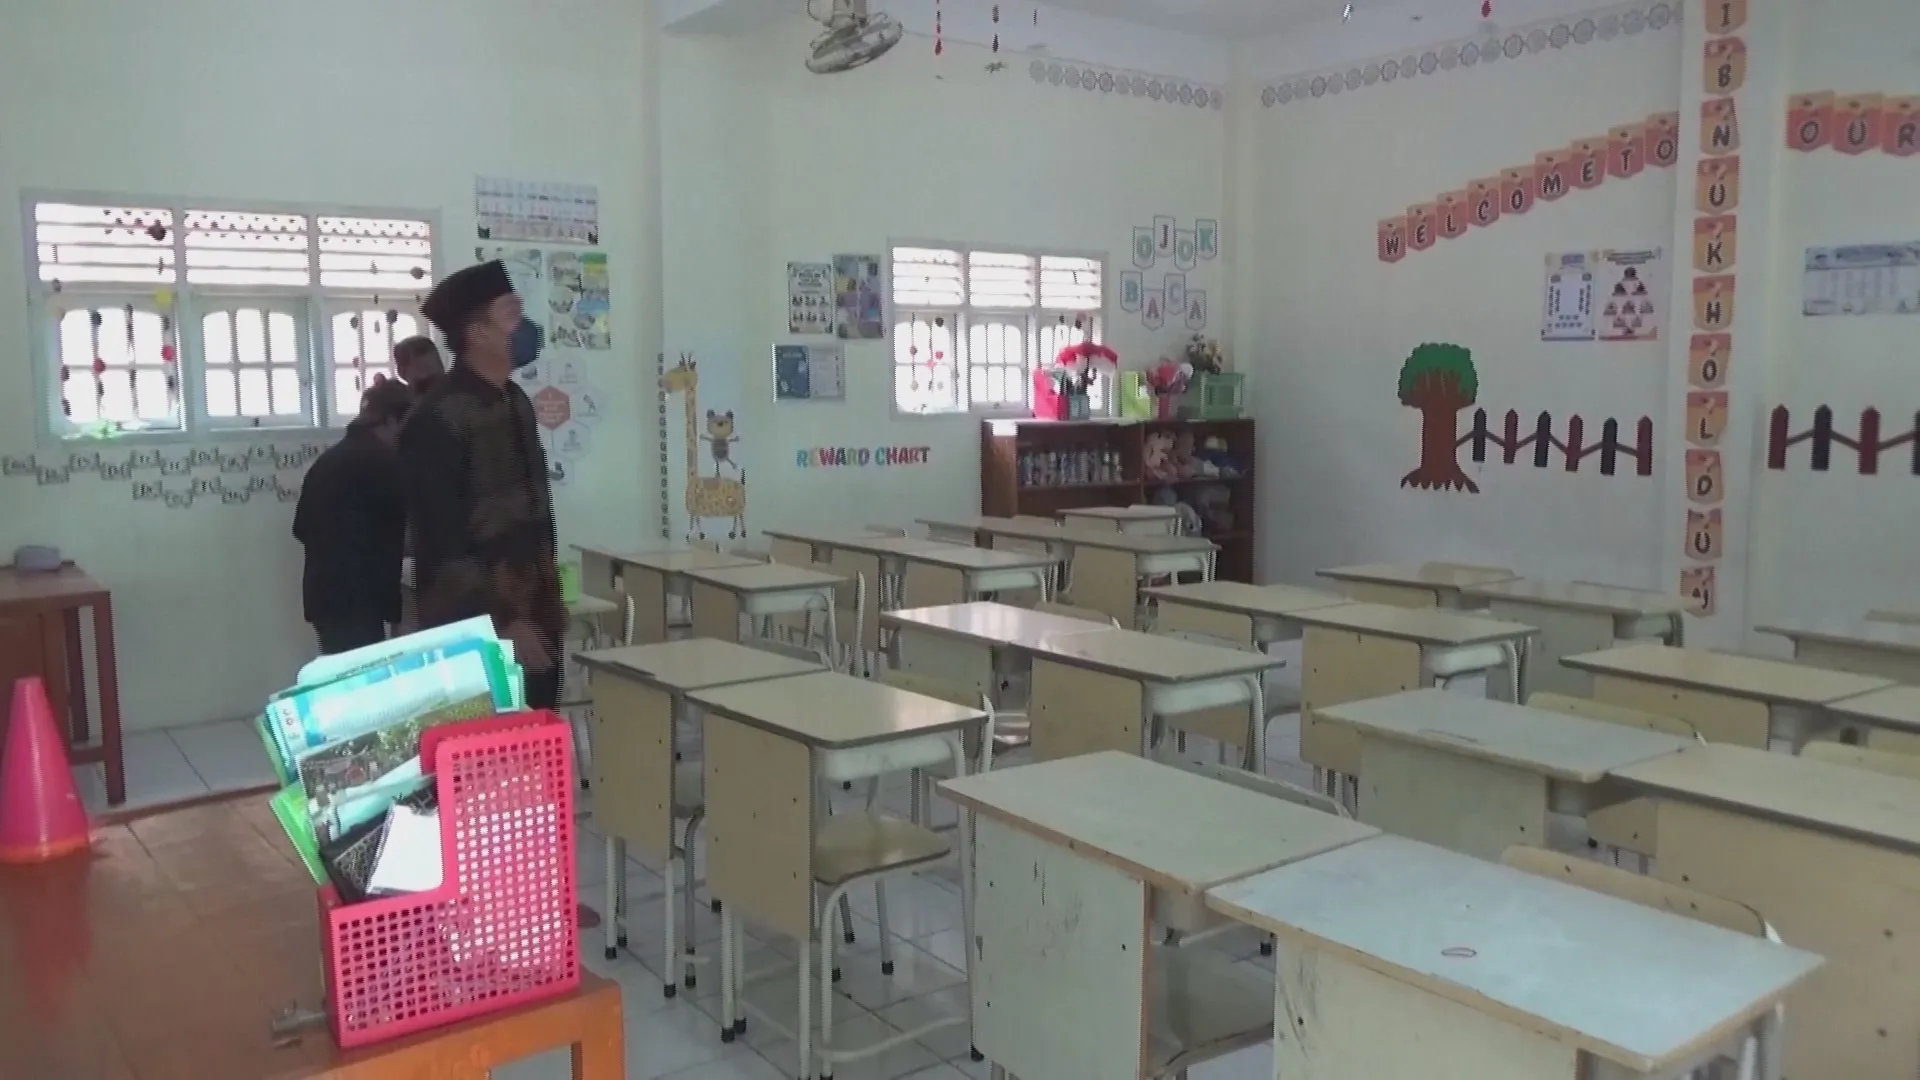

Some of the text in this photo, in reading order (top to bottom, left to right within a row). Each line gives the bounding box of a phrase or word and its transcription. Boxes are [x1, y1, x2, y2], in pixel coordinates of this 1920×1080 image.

[1800, 121, 1917, 149] OUR
[1125, 280, 1202, 319] BACA
[796, 446, 931, 468] REWARD CHART
